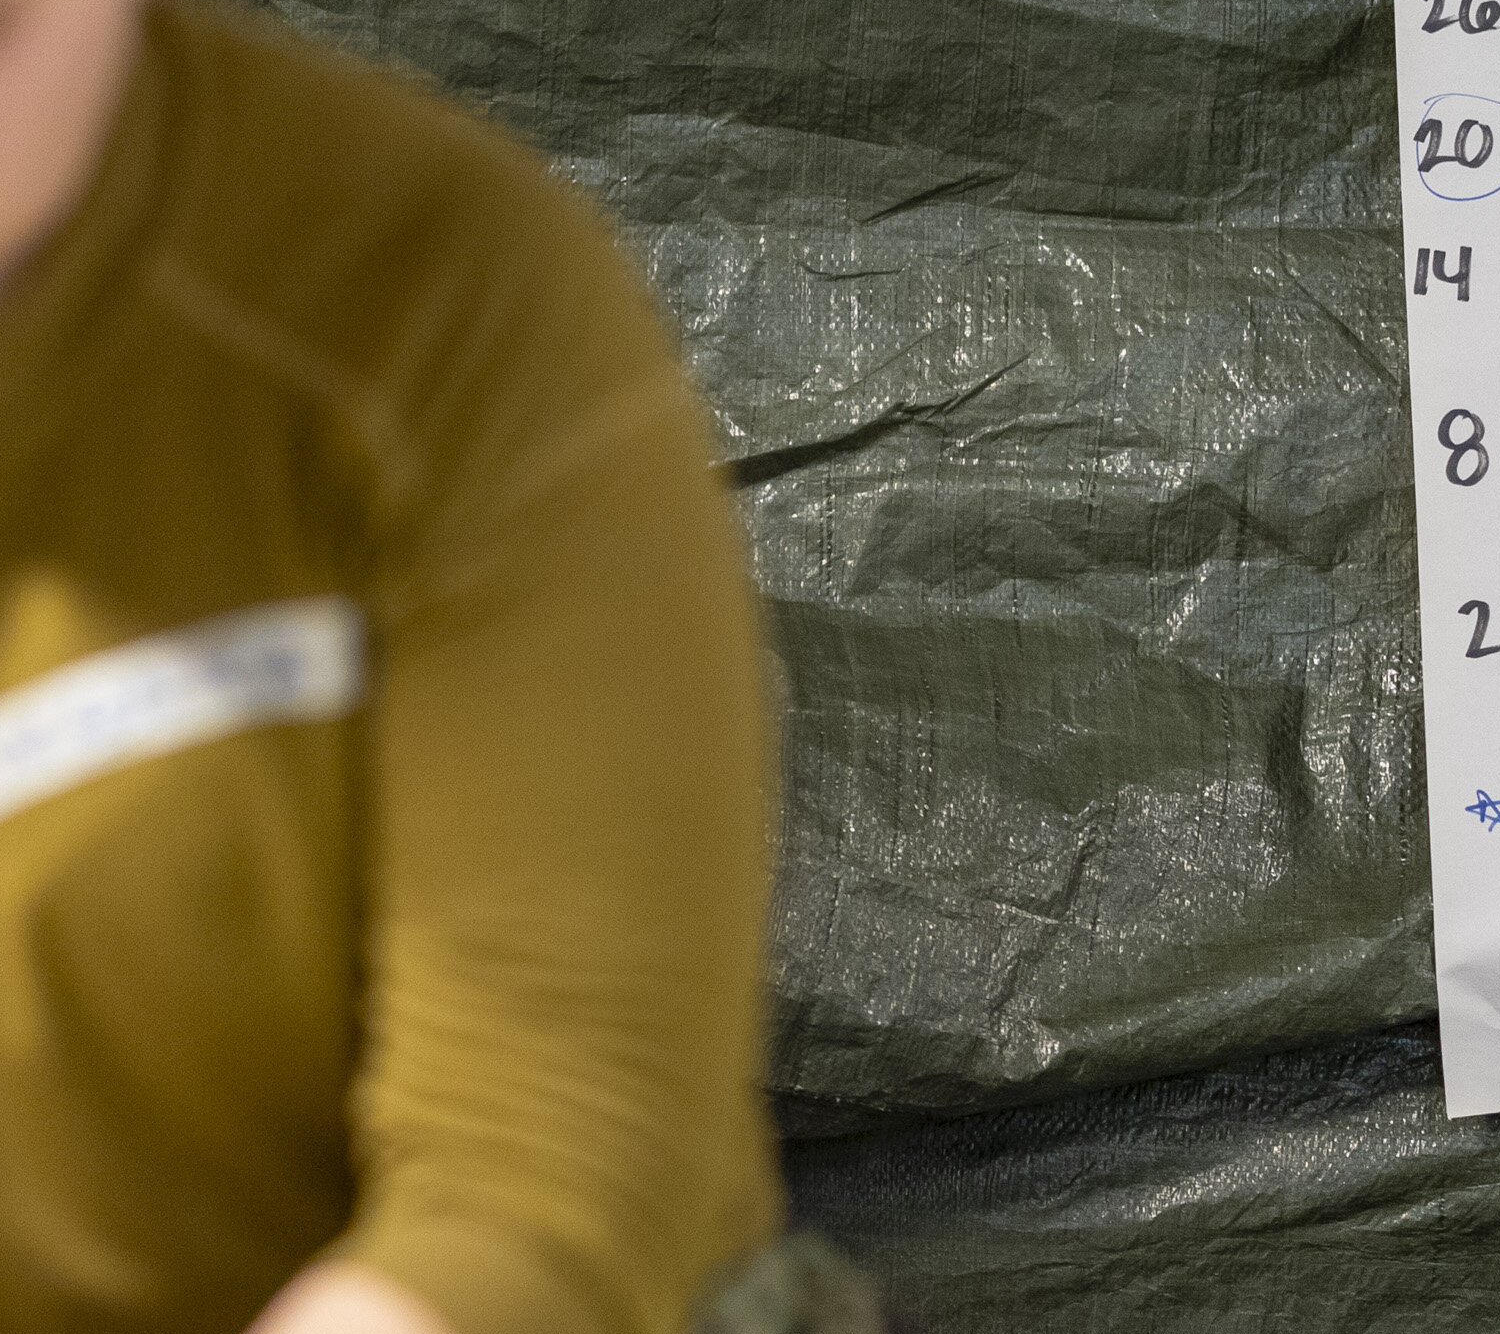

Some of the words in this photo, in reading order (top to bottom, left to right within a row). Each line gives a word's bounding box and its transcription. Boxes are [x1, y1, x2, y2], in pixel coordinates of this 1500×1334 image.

[1413, 117, 1495, 173] 20
[1412, 245, 1473, 302] 14
[1437, 408, 1491, 487] 8
